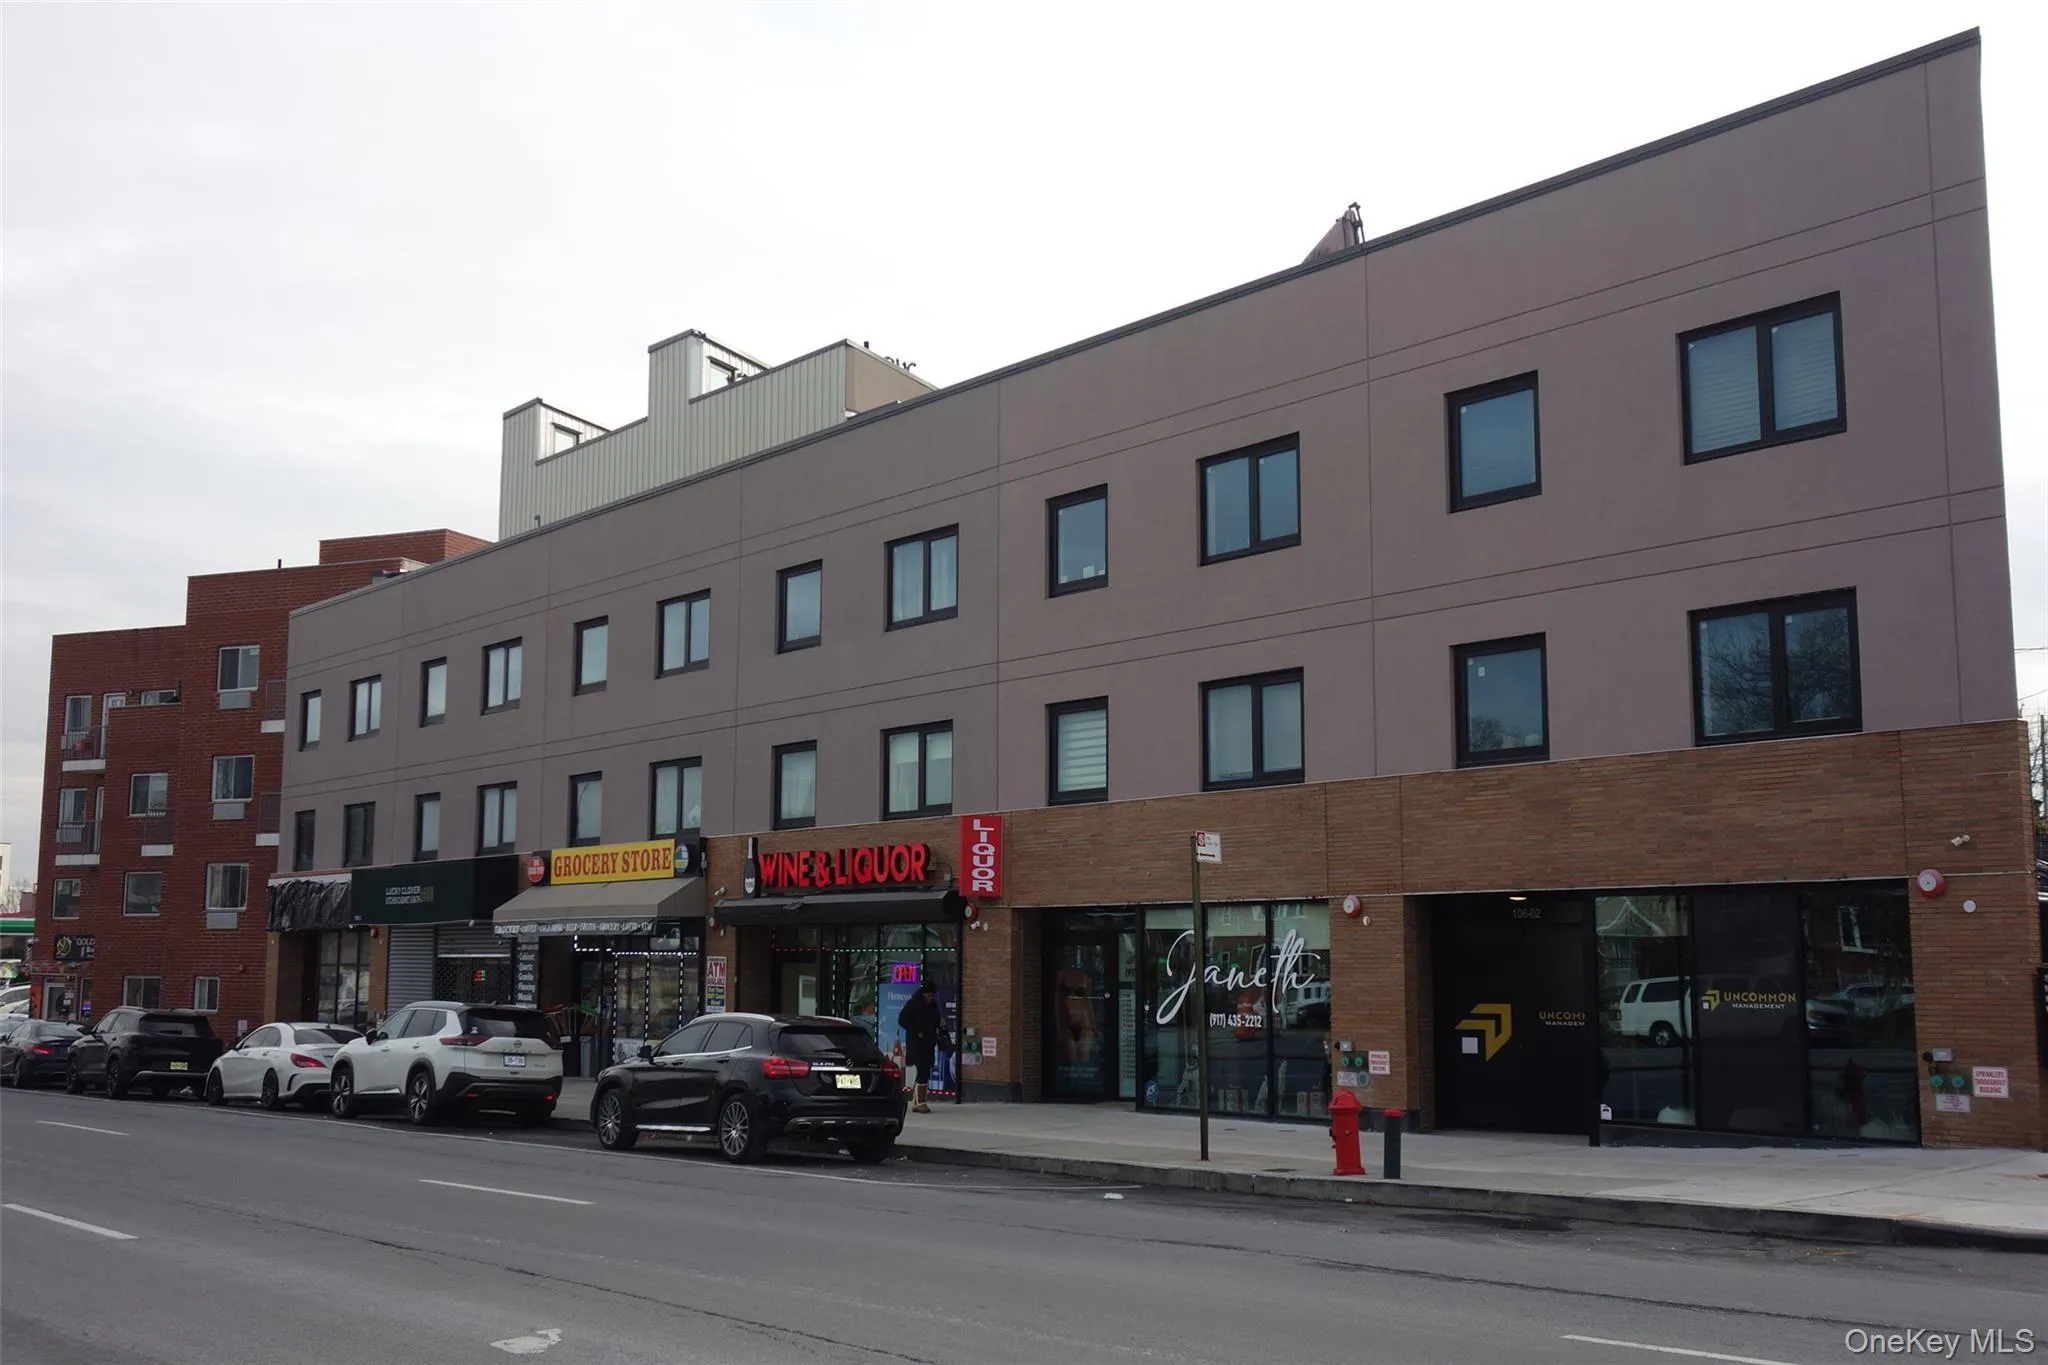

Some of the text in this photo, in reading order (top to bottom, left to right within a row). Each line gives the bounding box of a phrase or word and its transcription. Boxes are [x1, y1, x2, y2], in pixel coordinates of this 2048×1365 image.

[553, 852, 620, 878] GROCERY
[621, 847, 672, 874] STORE
[758, 850, 812, 888] WINE
[834, 842, 930, 884] LIQUOR
[971, 818, 995, 892] LIQUOR
[1512, 907, 1542, 919] 106-02
[707, 962, 726, 978] ATM
[1156, 928, 1321, 1025] Janeth
[1723, 992, 1797, 1003] UNCOMMON
[1208, 1012, 1263, 1029] (917) 435-2212
